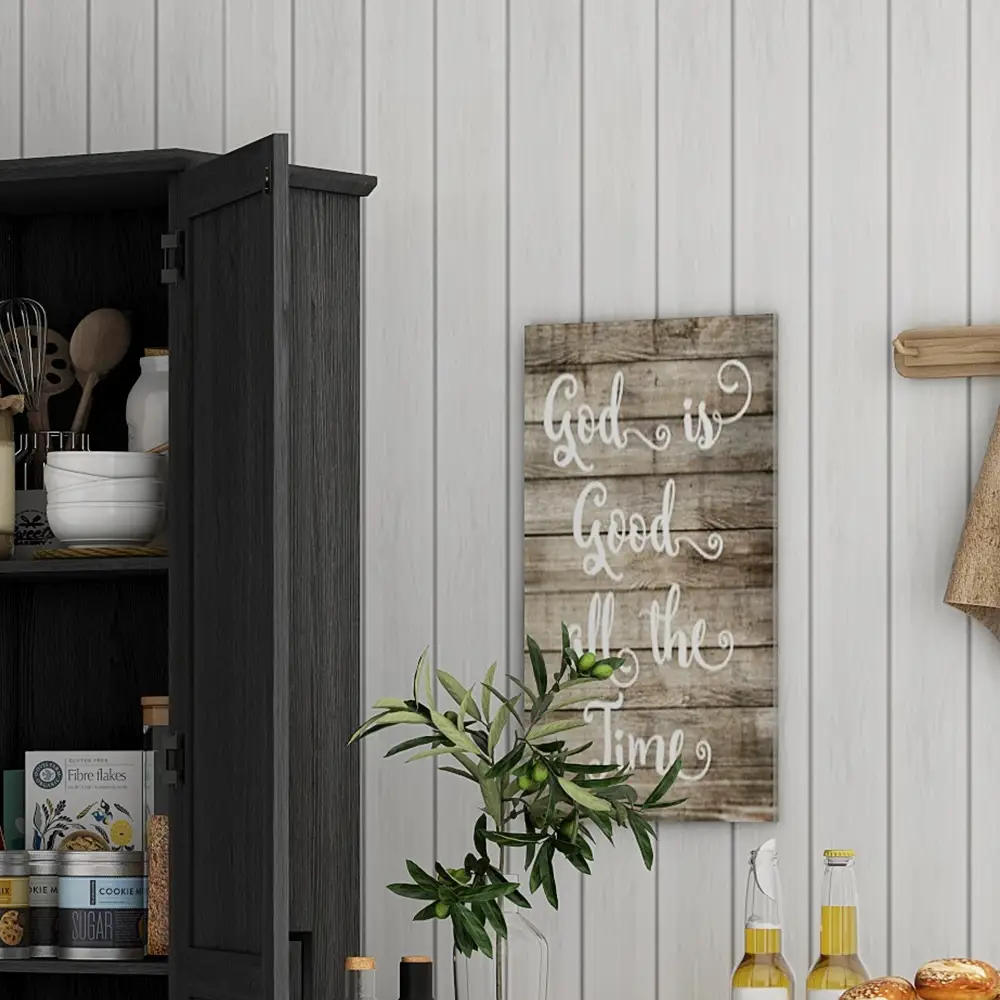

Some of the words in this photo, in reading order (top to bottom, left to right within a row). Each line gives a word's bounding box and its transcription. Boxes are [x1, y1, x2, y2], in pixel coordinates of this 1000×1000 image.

[544, 370, 671, 471] God
[683, 359, 752, 450] is
[573, 478, 723, 582] Good
[639, 583, 734, 672] the
[67, 768, 94, 782] Fibre
[96, 768, 127, 782] flakes
[583, 692, 712, 781] Time
[72, 911, 113, 941] SUGAR
[98, 888, 133, 896] COOKIE
